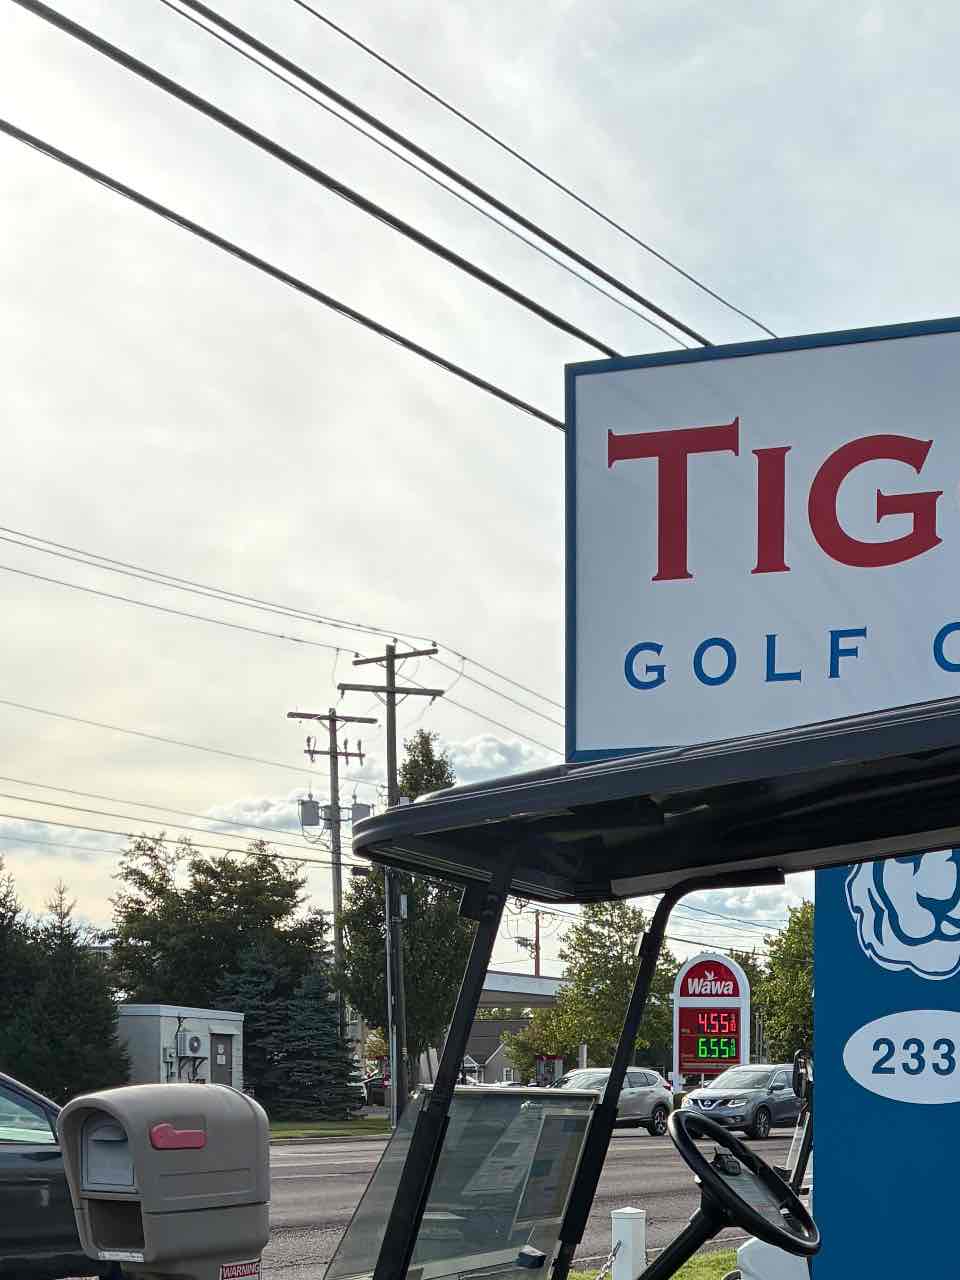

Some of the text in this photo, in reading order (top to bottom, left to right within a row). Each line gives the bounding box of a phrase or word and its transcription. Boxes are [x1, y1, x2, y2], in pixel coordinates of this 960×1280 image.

[624, 626, 867, 690] GOLF
[688, 978, 733, 994] Wawa
[223, 1264, 259, 1278] WARNING
